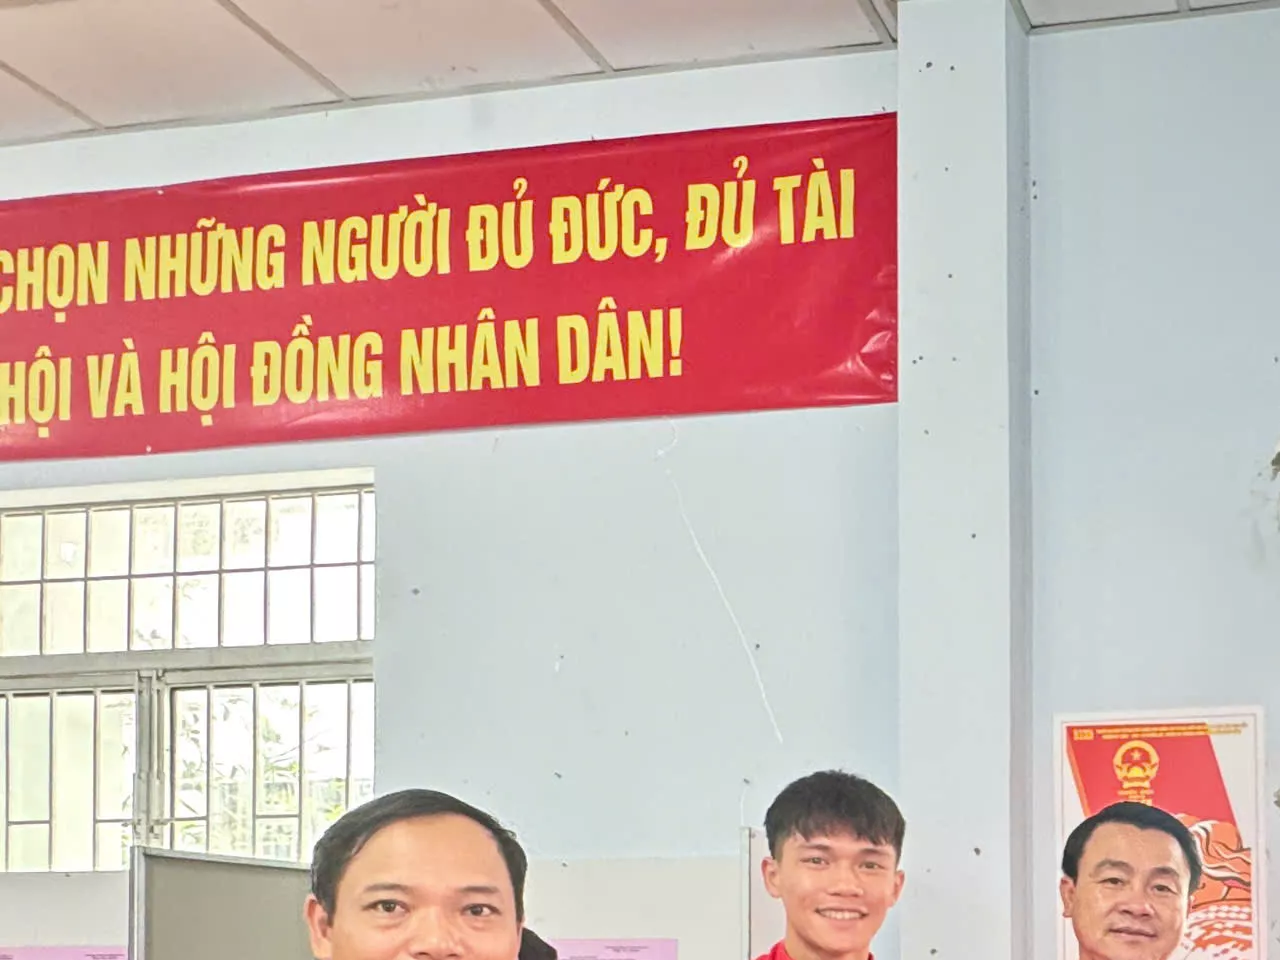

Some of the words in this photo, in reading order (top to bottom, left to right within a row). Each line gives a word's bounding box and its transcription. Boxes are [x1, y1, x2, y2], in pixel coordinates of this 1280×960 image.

[0, 243, 108, 324] CHỌN
[125, 218, 285, 301] NHỮNG
[303, 203, 450, 299] NGƯỜI
[467, 177, 533, 271] ĐỦ
[550, 178, 667, 264] ĐỨC,
[686, 156, 757, 252] ĐỦ
[774, 167, 854, 244] TÀI
[0, 345, 71, 437] HỘI
[88, 338, 143, 418] VÀ
[160, 332, 235, 426] HỘI
[251, 315, 382, 406] ĐỒNG
[402, 308, 539, 395] NHÂN
[557, 298, 682, 386] DÂN!
